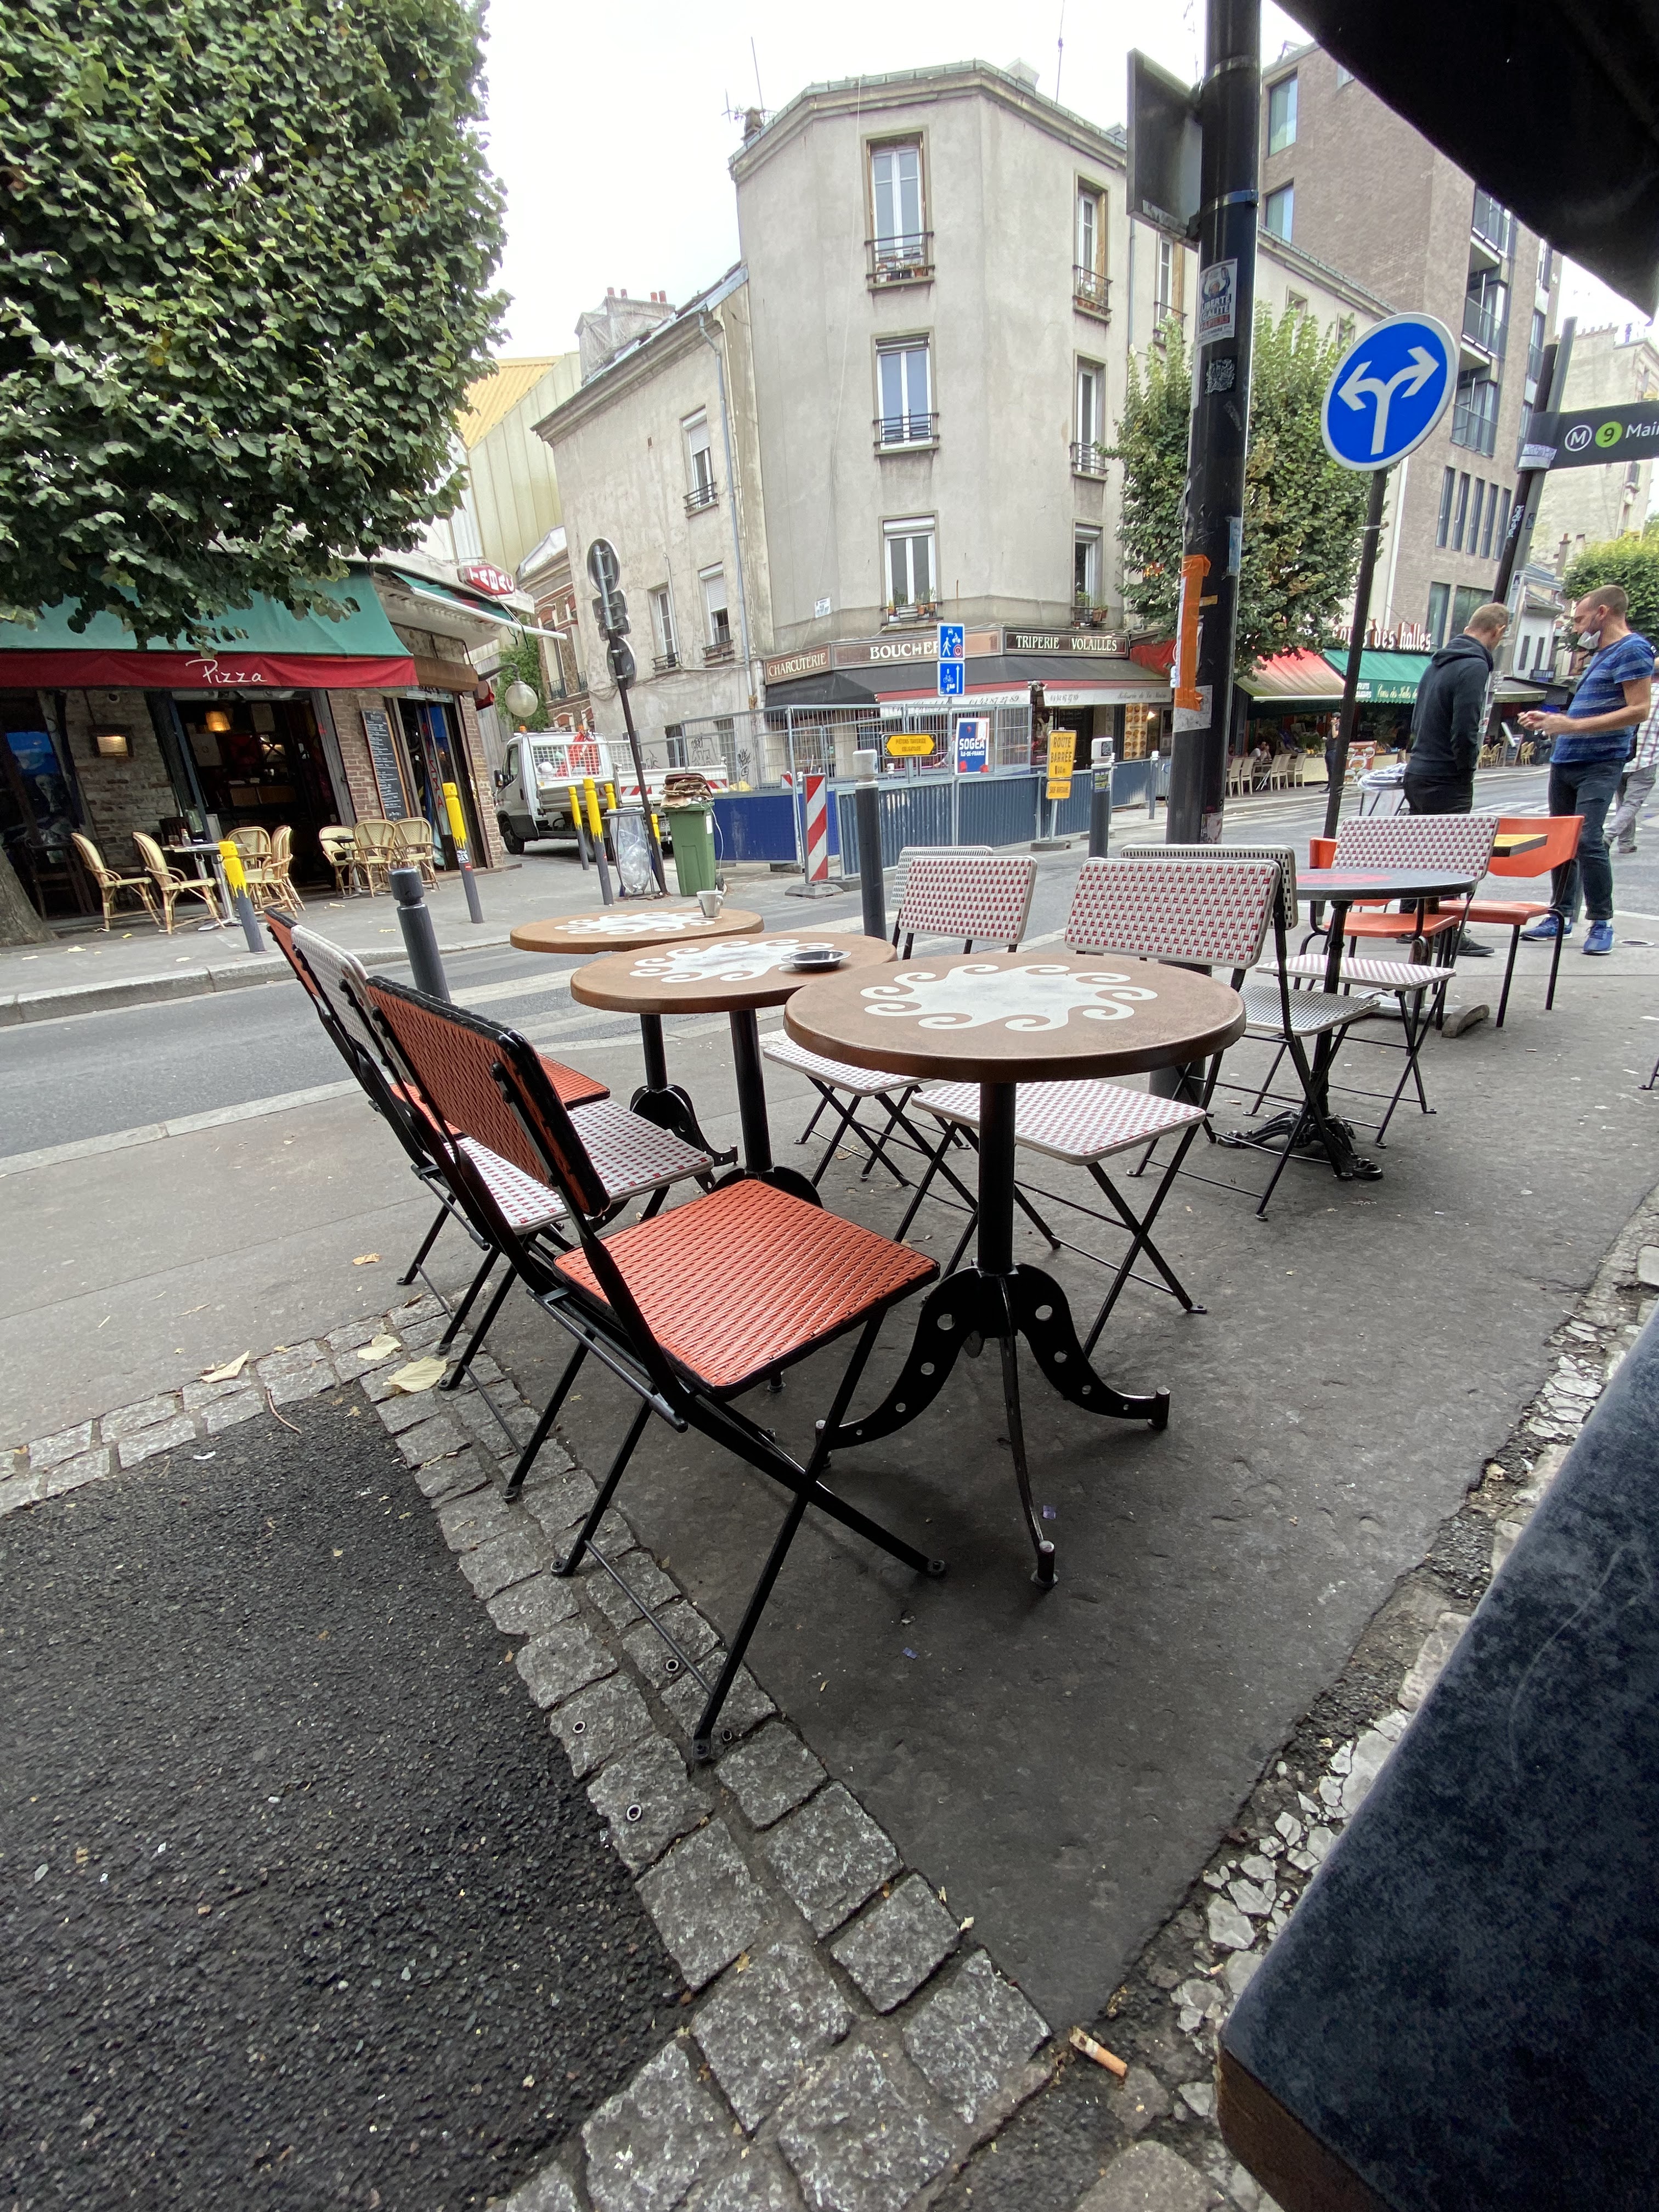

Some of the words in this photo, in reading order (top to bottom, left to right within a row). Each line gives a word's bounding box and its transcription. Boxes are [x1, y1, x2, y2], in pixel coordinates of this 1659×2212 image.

[1570, 430, 1587, 447] M
[1603, 427, 1615, 443] 9
[469, 567, 515, 592] TABAC
[1016, 635, 1060, 649] TRIPERIE
[1071, 637, 1117, 652] VOLAILLES
[1374, 618, 1395, 649] des
[1399, 621, 1432, 652] halles
[185, 658, 268, 684] Pizza
[769, 652, 827, 677] CHARCUTERIE
[959, 738, 985, 750] SOGEA
[1053, 737, 1071, 748] ROUTE
[1051, 749, 1072, 763] BARRÉE
